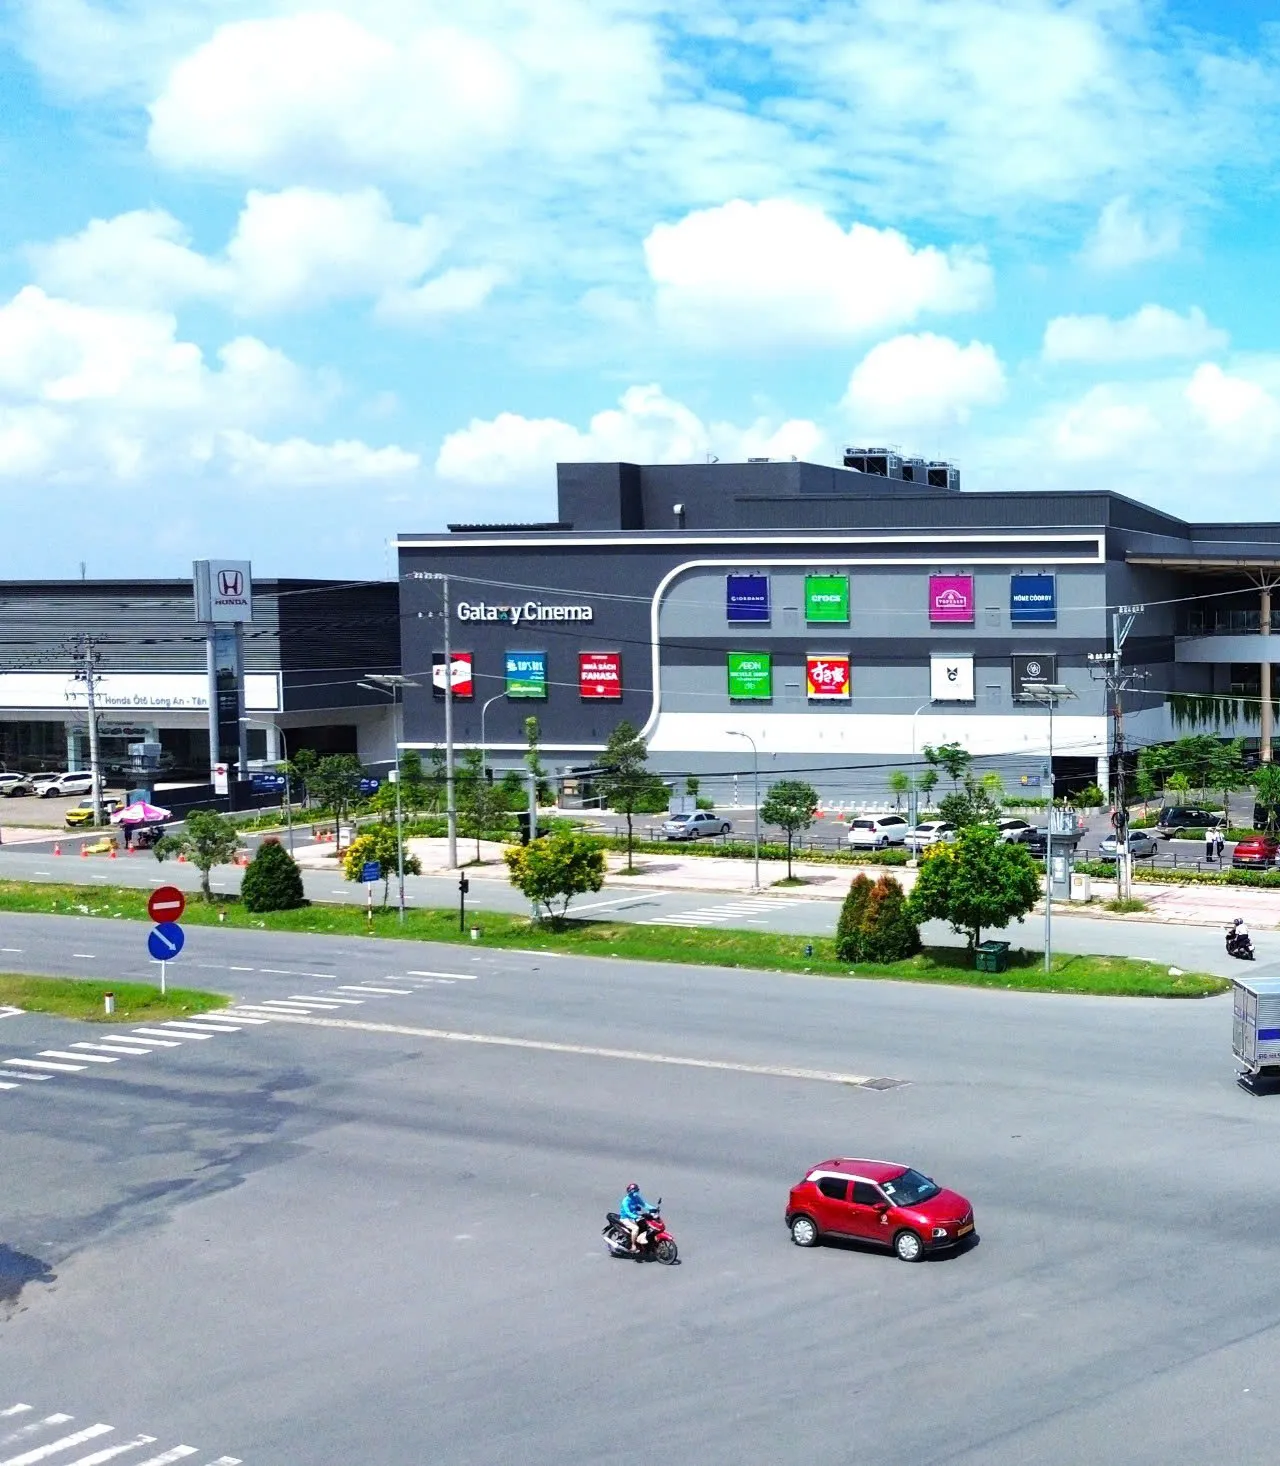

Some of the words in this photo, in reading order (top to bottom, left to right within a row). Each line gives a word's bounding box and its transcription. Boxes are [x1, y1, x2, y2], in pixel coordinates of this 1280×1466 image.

[524, 602, 593, 621] Cinema
[581, 672, 619, 680] FAHASA
[105, 696, 131, 705] Honda
[150, 696, 171, 707] Long
[173, 696, 184, 705] An
